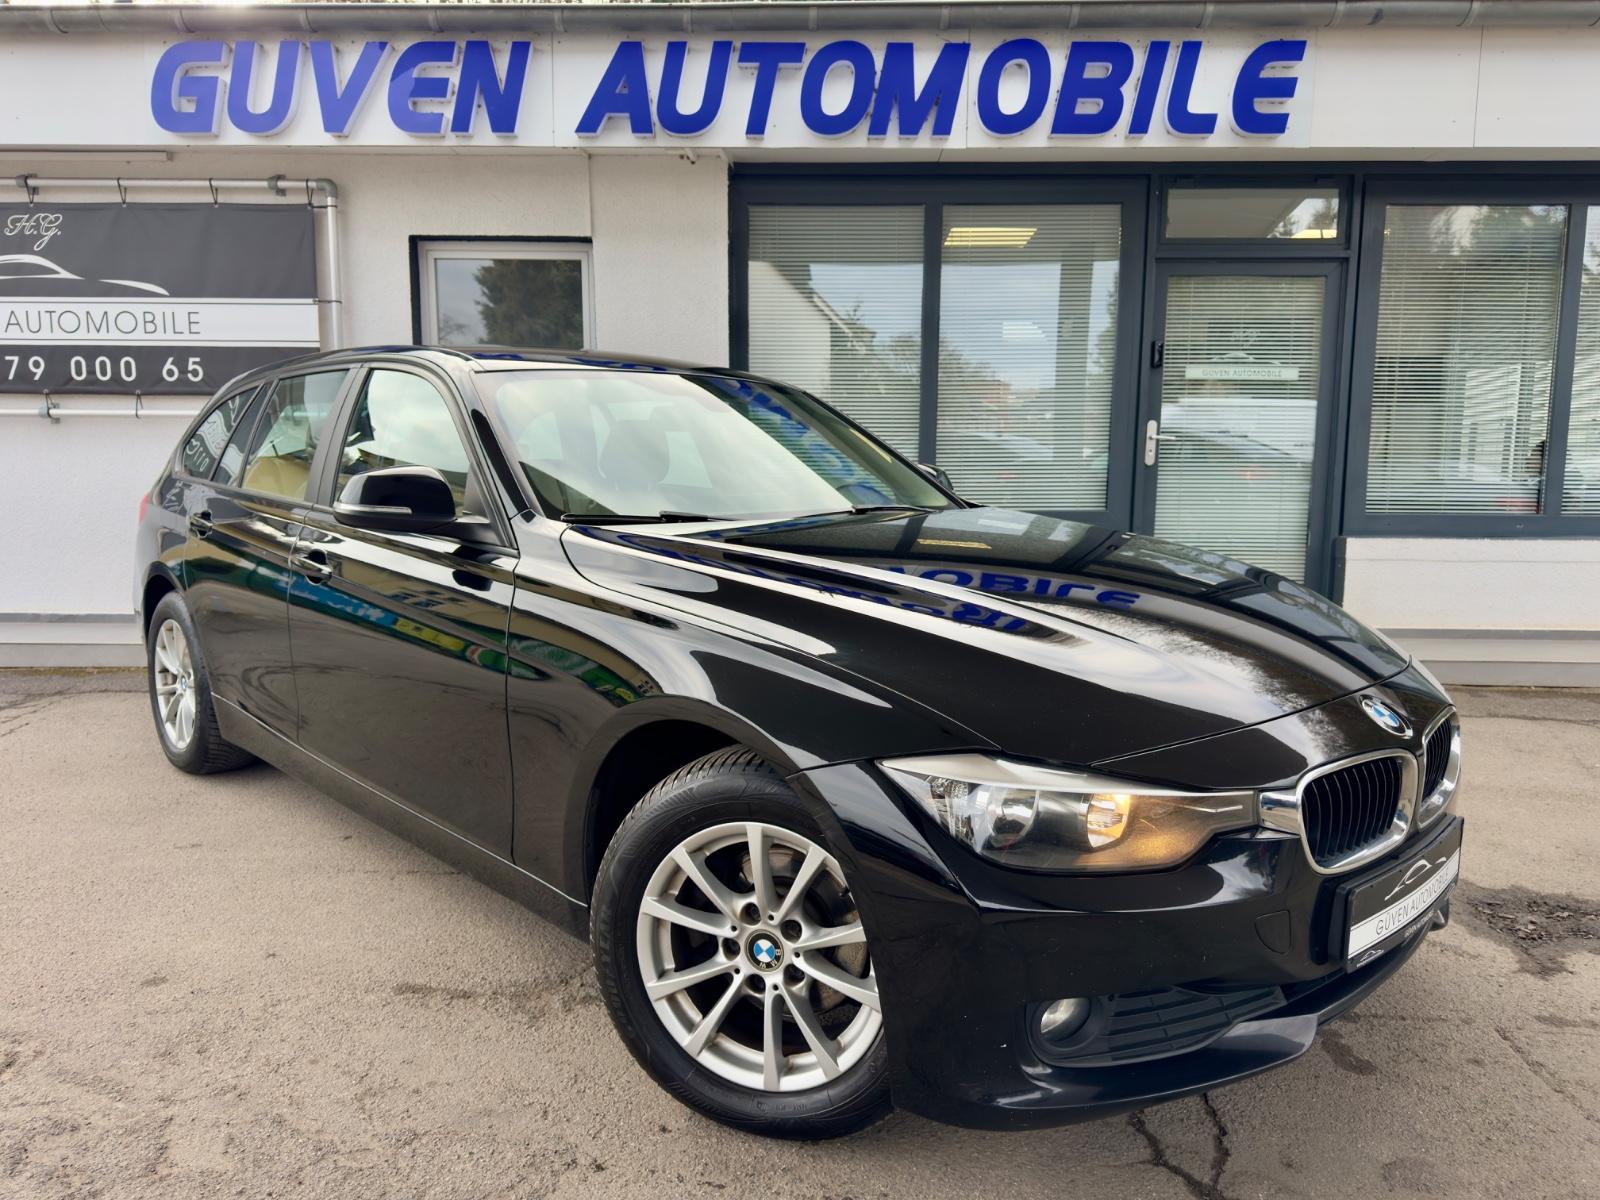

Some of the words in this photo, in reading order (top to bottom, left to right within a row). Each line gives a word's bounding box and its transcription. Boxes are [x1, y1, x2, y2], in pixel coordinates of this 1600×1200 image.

[150, 40, 533, 137] GUVEN
[575, 39, 1307, 139] AUTOMOBILE
[4, 310, 201, 335] AUTOMOBILE
[5, 355, 45, 380] 79
[70, 356, 137, 381] 000
[162, 357, 204, 382] 65
